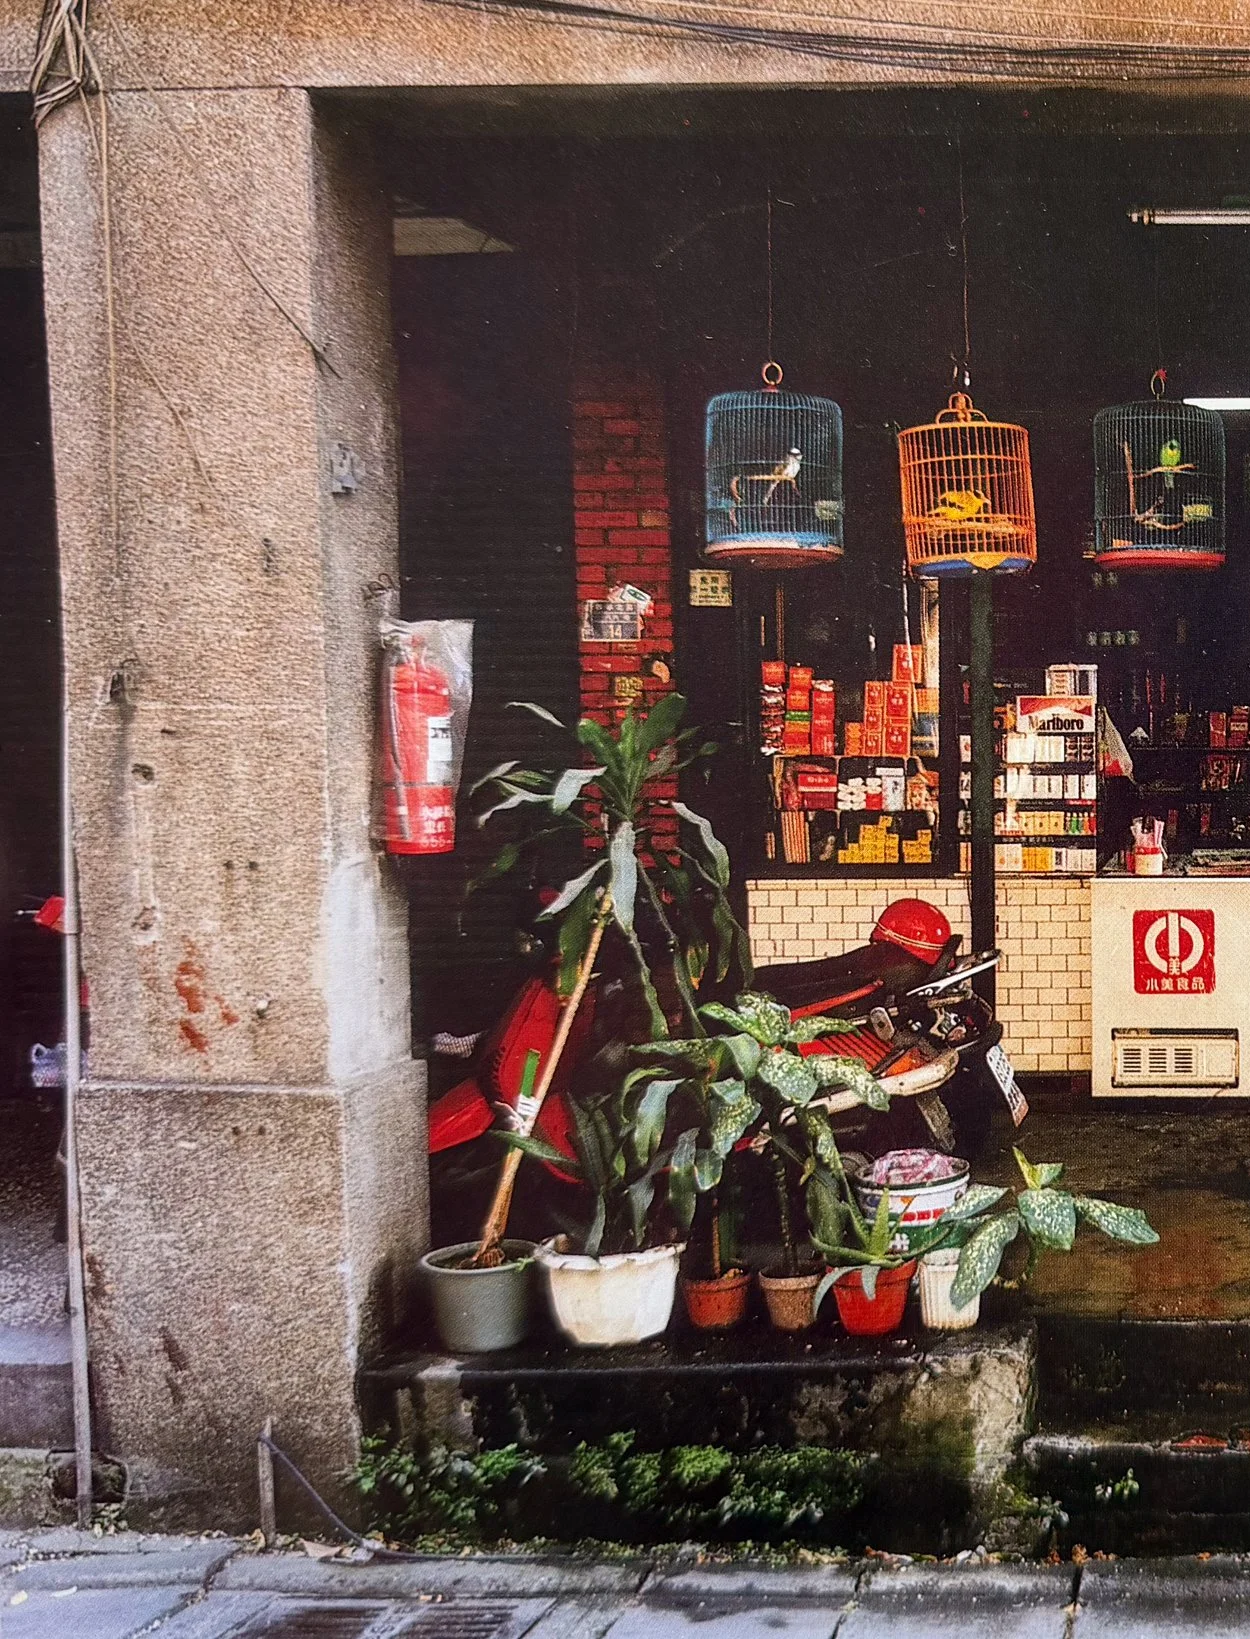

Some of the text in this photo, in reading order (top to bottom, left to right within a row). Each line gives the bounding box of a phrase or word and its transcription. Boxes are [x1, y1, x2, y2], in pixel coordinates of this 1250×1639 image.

[1028, 715, 1084, 731] Marlboro
[1145, 976, 1205, 991] 小美食品
